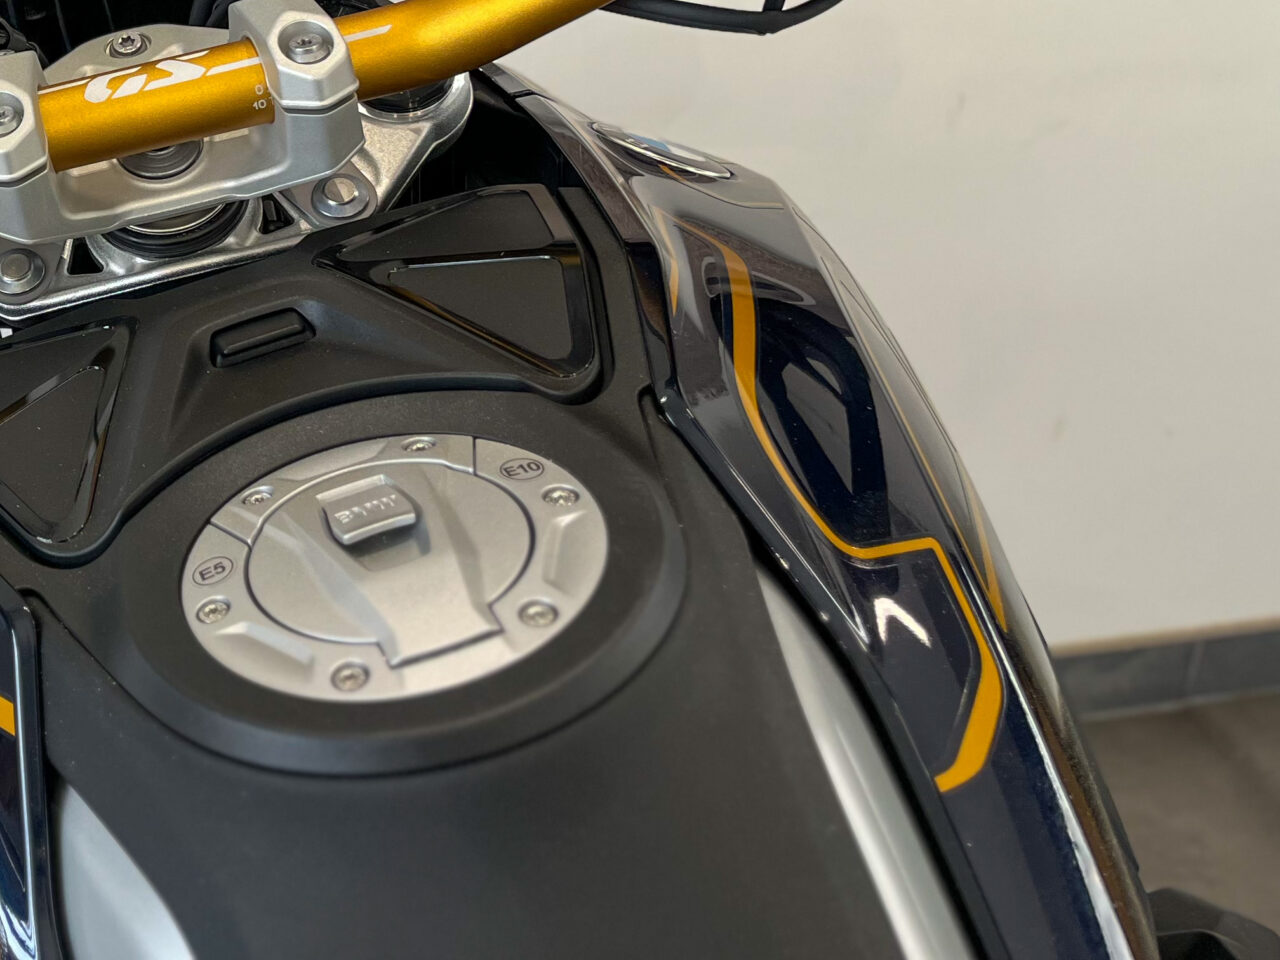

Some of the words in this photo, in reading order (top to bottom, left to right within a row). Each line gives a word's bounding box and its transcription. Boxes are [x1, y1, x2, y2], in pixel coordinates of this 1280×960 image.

[84, 60, 206, 103] GS
[255, 84, 264, 95] 0
[253, 99, 267, 110] 10
[503, 461, 541, 477] E10
[199, 561, 226, 581] E5
